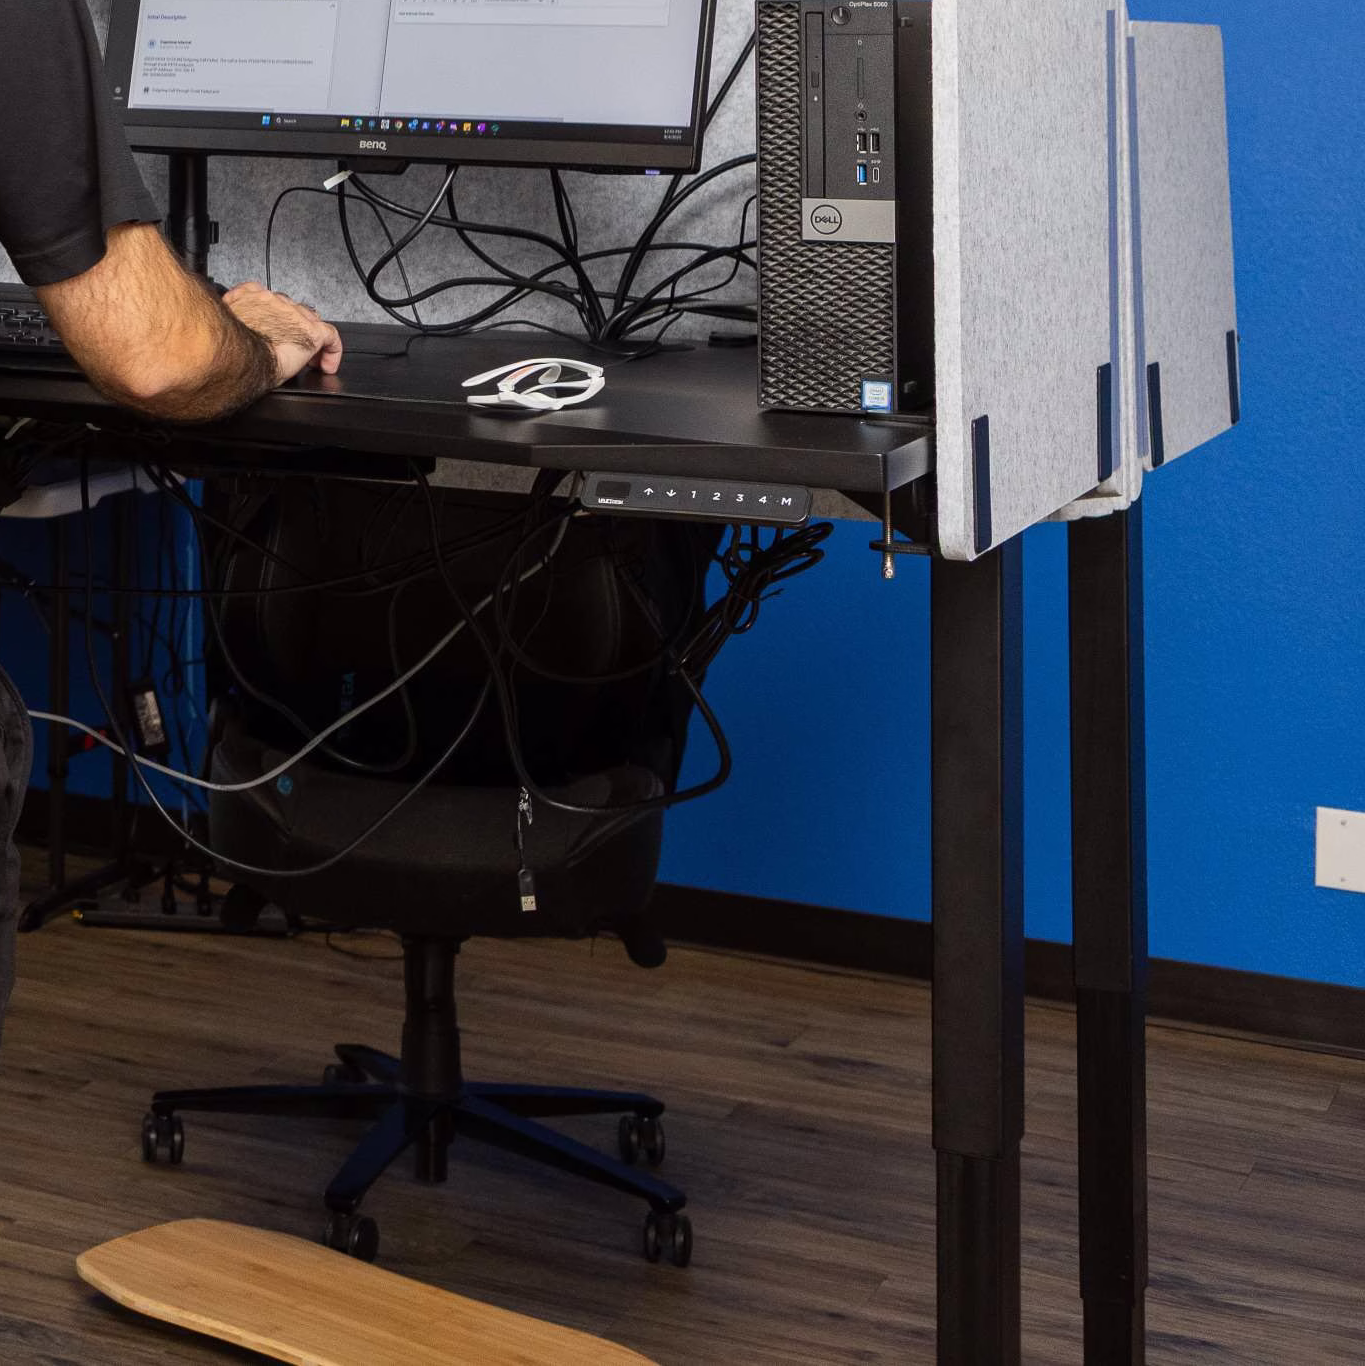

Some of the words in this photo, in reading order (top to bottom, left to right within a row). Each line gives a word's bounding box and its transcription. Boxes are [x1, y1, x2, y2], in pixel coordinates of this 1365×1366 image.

[849, 1, 873, 9] OptiPlex
[359, 140, 387, 151] BenQ
[814, 216, 839, 224] DELL
[691, 490, 697, 499] 1
[712, 492, 721, 501] 2
[736, 494, 744, 503] 3
[758, 495, 767, 505] 4
[781, 497, 792, 507] M
